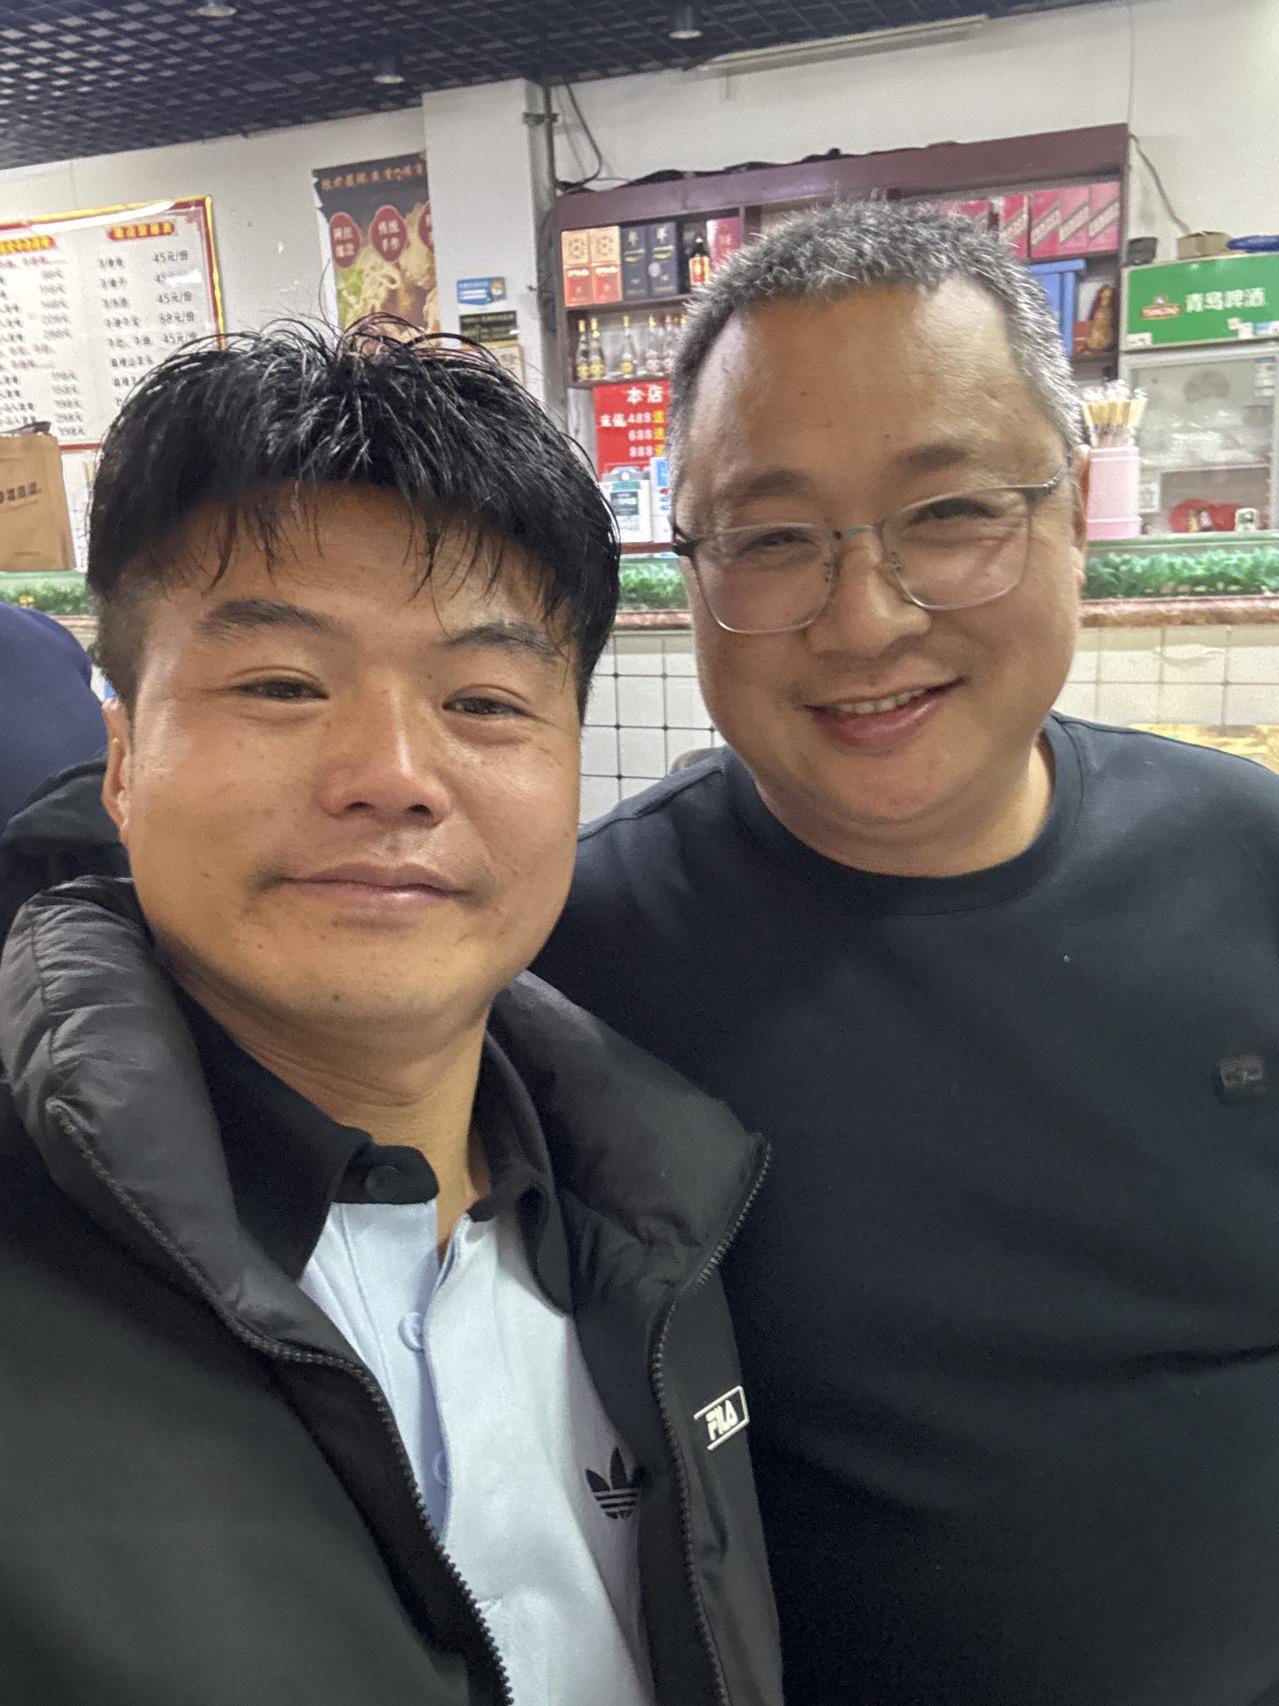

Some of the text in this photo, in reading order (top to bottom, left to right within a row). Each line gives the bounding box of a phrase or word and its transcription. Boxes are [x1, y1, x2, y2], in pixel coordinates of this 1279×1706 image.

[152, 249, 189, 263] 45元/份
[156, 291, 193, 304] 45元/份
[1186, 288, 1266, 313] 青岛啤酒
[705, 1400, 739, 1441] FILA
